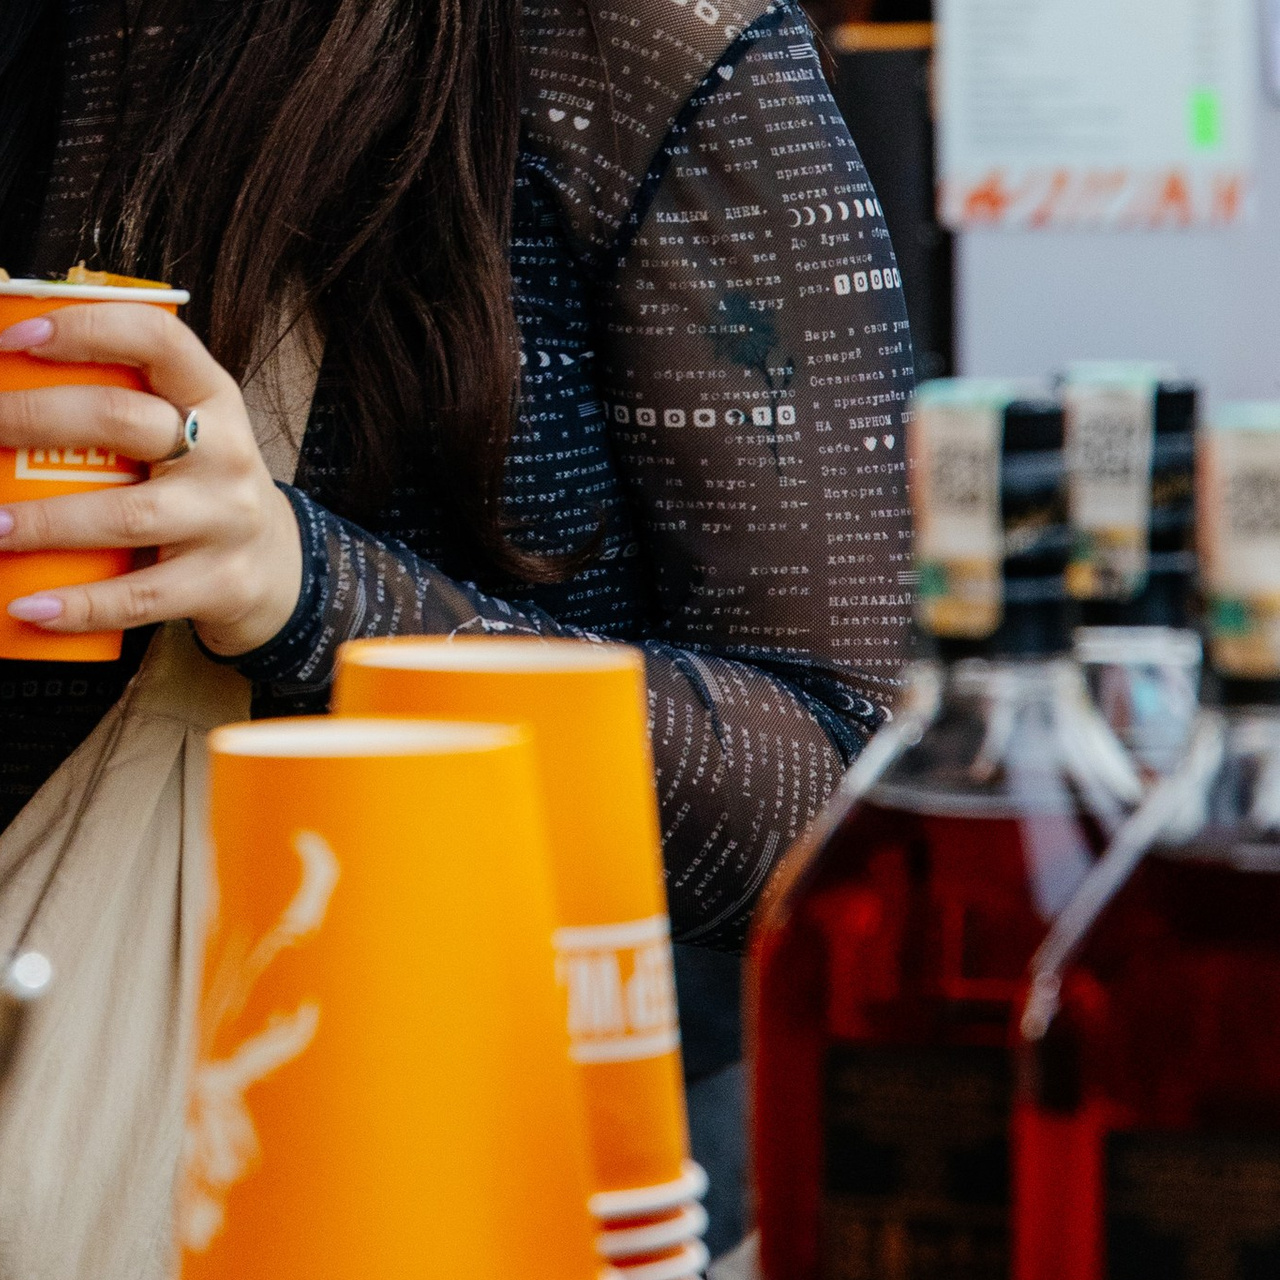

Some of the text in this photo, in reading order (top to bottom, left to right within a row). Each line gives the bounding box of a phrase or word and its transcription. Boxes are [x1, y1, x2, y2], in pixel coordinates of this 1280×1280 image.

[539, 89, 652, 139] ВЕРНОМ ПУТИ.
[697, 112, 749, 130] ты об-
[765, 118, 814, 133] плохое.
[699, 142, 719, 153] ты
[728, 136, 754, 149] так
[770, 141, 832, 157] циклично.
[724, 159, 760, 173] этот
[776, 163, 833, 181] приходит
[782, 187, 828, 203] всегда
[656, 205, 768, 224] КАЖДЫМ ДНЕМ.
[659, 235, 685, 246] все
[791, 238, 807, 251] До
[820, 232, 850, 247] Луны
[641, 257, 698, 270] помни,
[709, 256, 738, 267] что
[752, 252, 777, 264] все
[795, 253, 873, 271] бесконечное
[636, 279, 655, 290] За
[726, 274, 782, 289] всегда
[799, 283, 831, 298] раз.
[640, 298, 784, 315] утро. А луну
[686, 323, 754, 335] Солнце.
[804, 330, 836, 342] Верь
[848, 327, 855, 337] в
[807, 348, 862, 366] доверяй
[653, 370, 726, 382] обратно
[809, 371, 885, 387] Остановись
[700, 389, 796, 401] количество
[834, 390, 906, 410] прислушайся
[815, 414, 892, 432] НА ВЕРНОМ
[819, 443, 859, 454] себе.
[737, 455, 803, 468] города.
[821, 461, 906, 477] Это история
[706, 479, 756, 490] вкус.
[824, 487, 883, 499] История
[654, 500, 757, 512] ароматами,
[701, 523, 732, 533] шум
[827, 531, 889, 545] ретаешь
[749, 565, 809, 576] хочешь
[828, 576, 893, 586] момент.
[832, 637, 898, 647] плохое.
